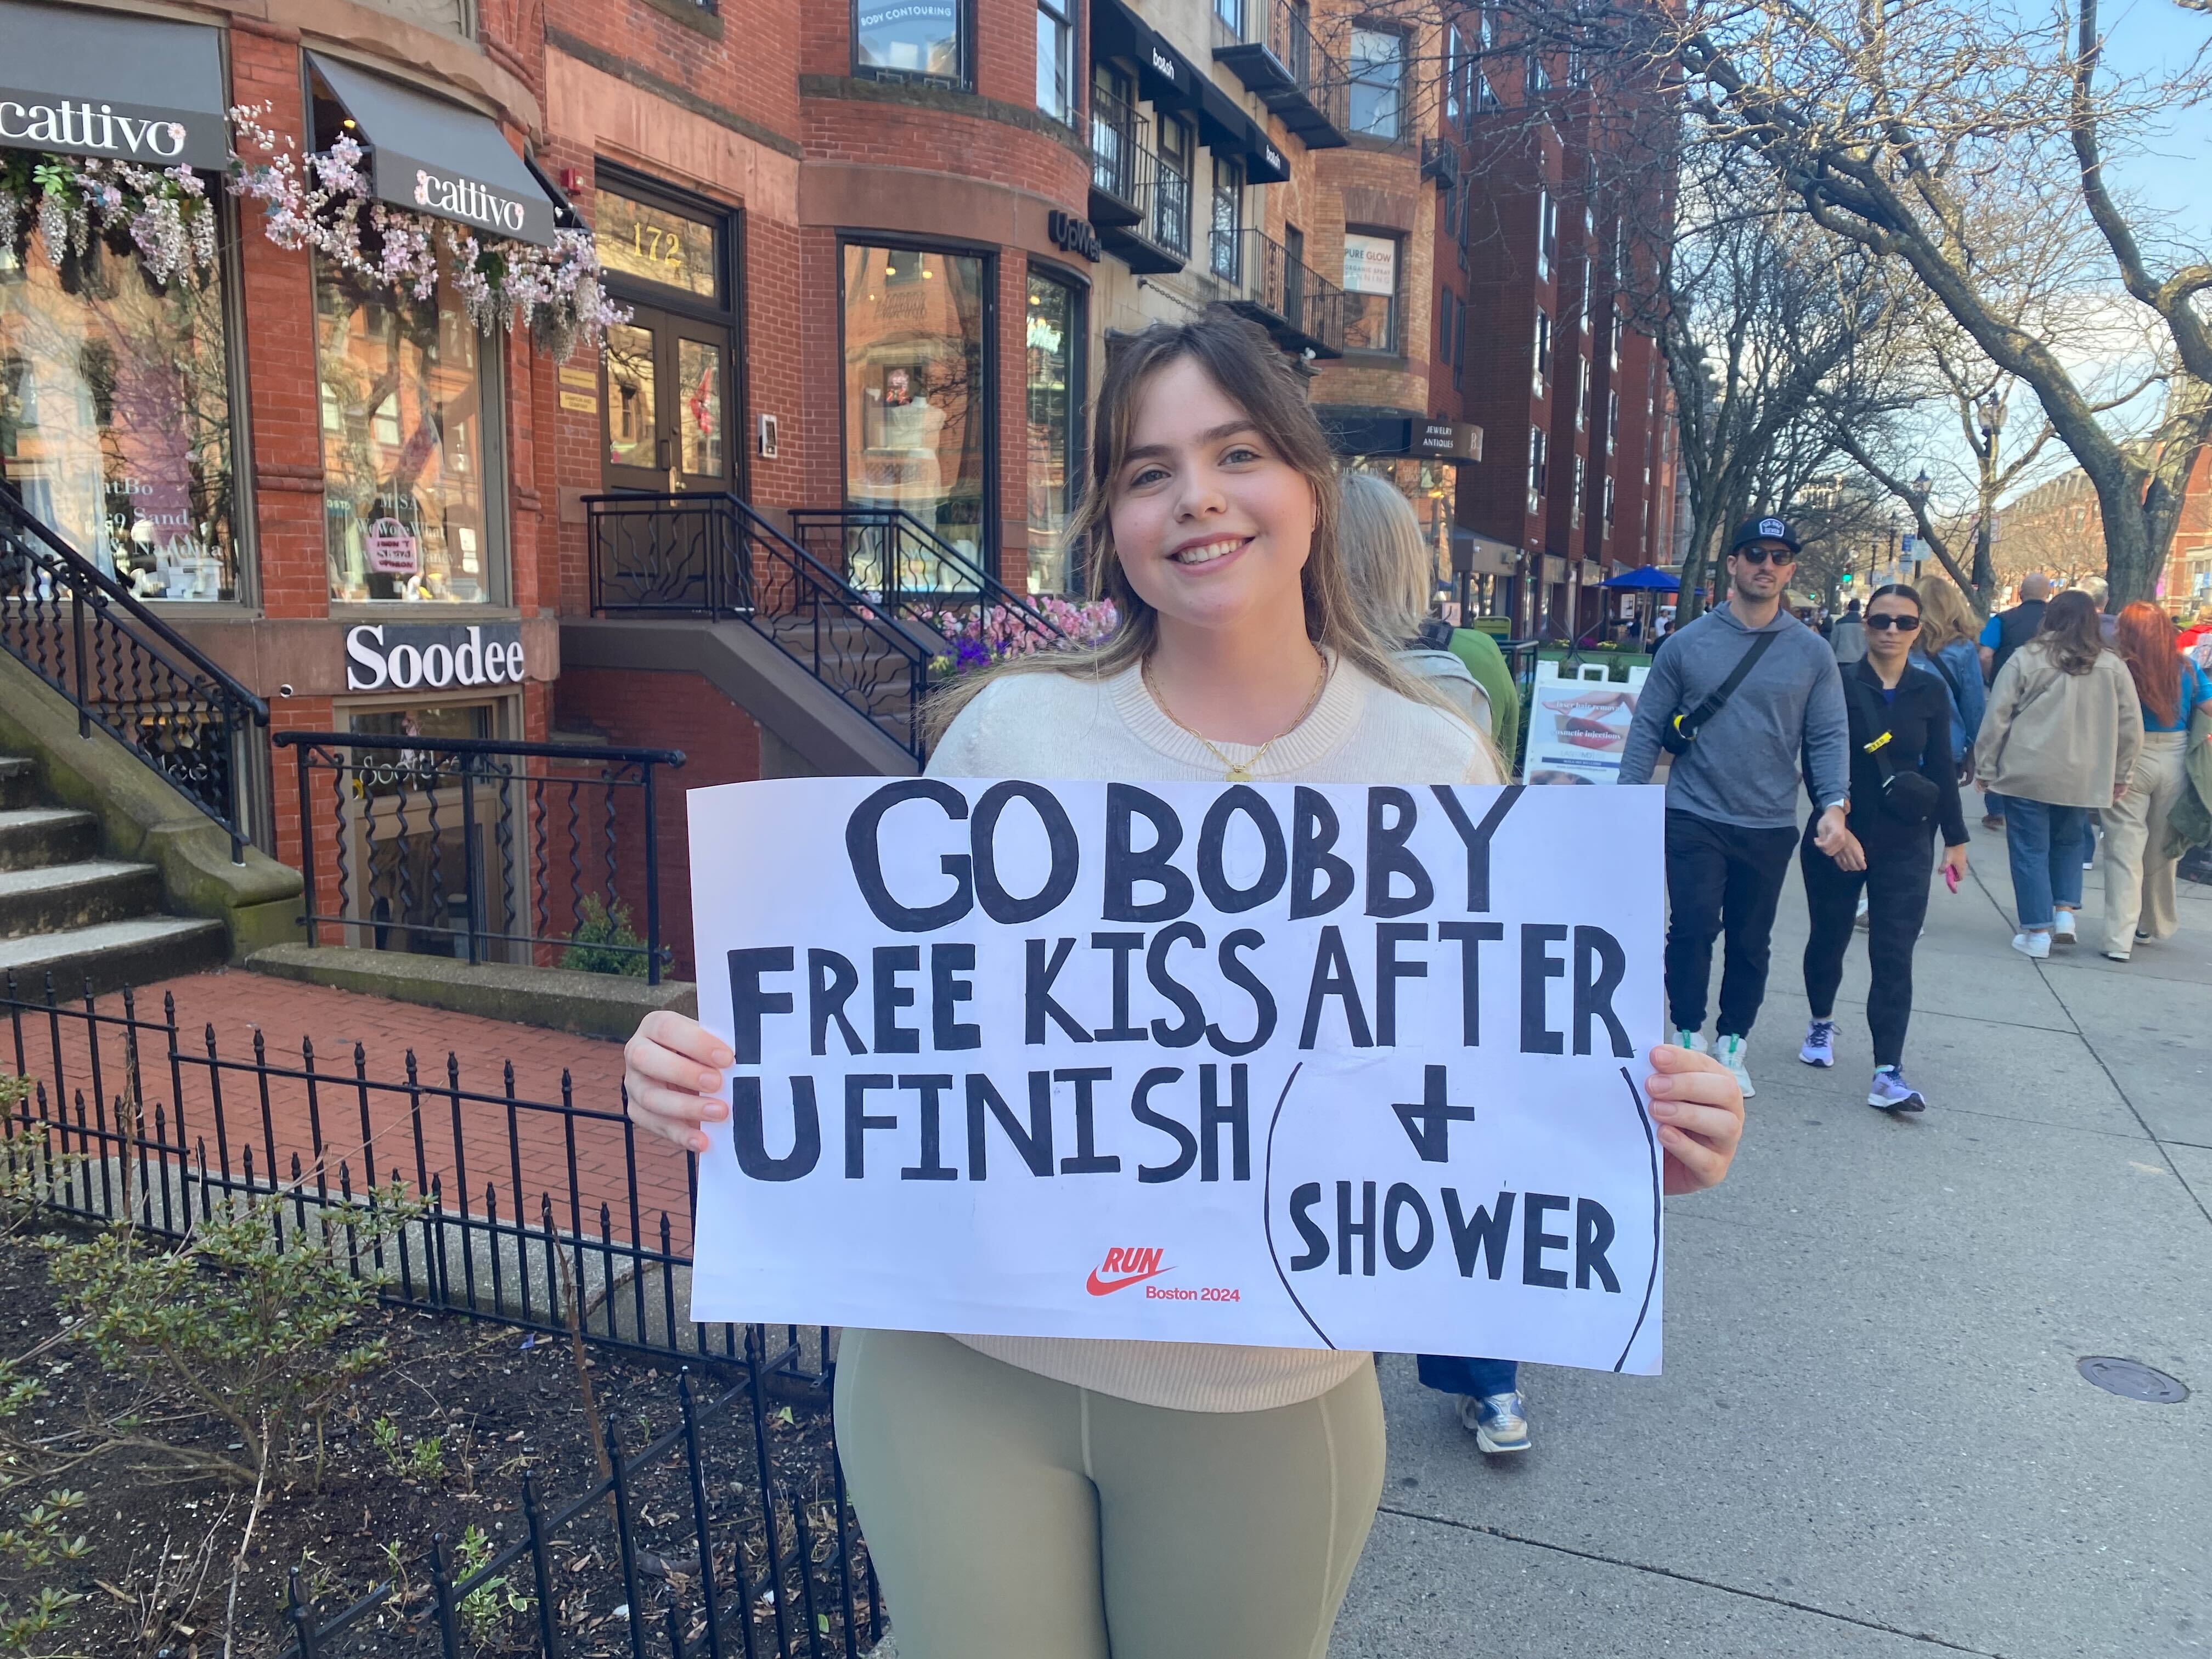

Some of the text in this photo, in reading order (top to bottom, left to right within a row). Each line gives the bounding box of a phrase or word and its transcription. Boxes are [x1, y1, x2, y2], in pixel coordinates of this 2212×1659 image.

[861, 6, 952, 26] BODY CONTOURING
[0, 100, 185, 157] cattivo
[421, 175, 524, 230] cattivo
[634, 222, 681, 267] 172
[1345, 248, 1392, 263] PURE GLOW
[1422, 438, 1454, 449] ANTIQUES
[1426, 425, 1452, 436] JEWELRY
[346, 624, 524, 691] Soodee
[1585, 730, 1621, 740] injections
[845, 779, 1527, 932] GO BOBBY
[727, 921, 1637, 1064] FREE KISS AFTER
[733, 1076, 821, 1181] U
[845, 1063, 1250, 1183] FINISH
[1290, 1181, 1621, 1293] SHOWER
[1102, 1247, 1164, 1274] RUN
[1146, 1286, 1240, 1302] Boston 2024
